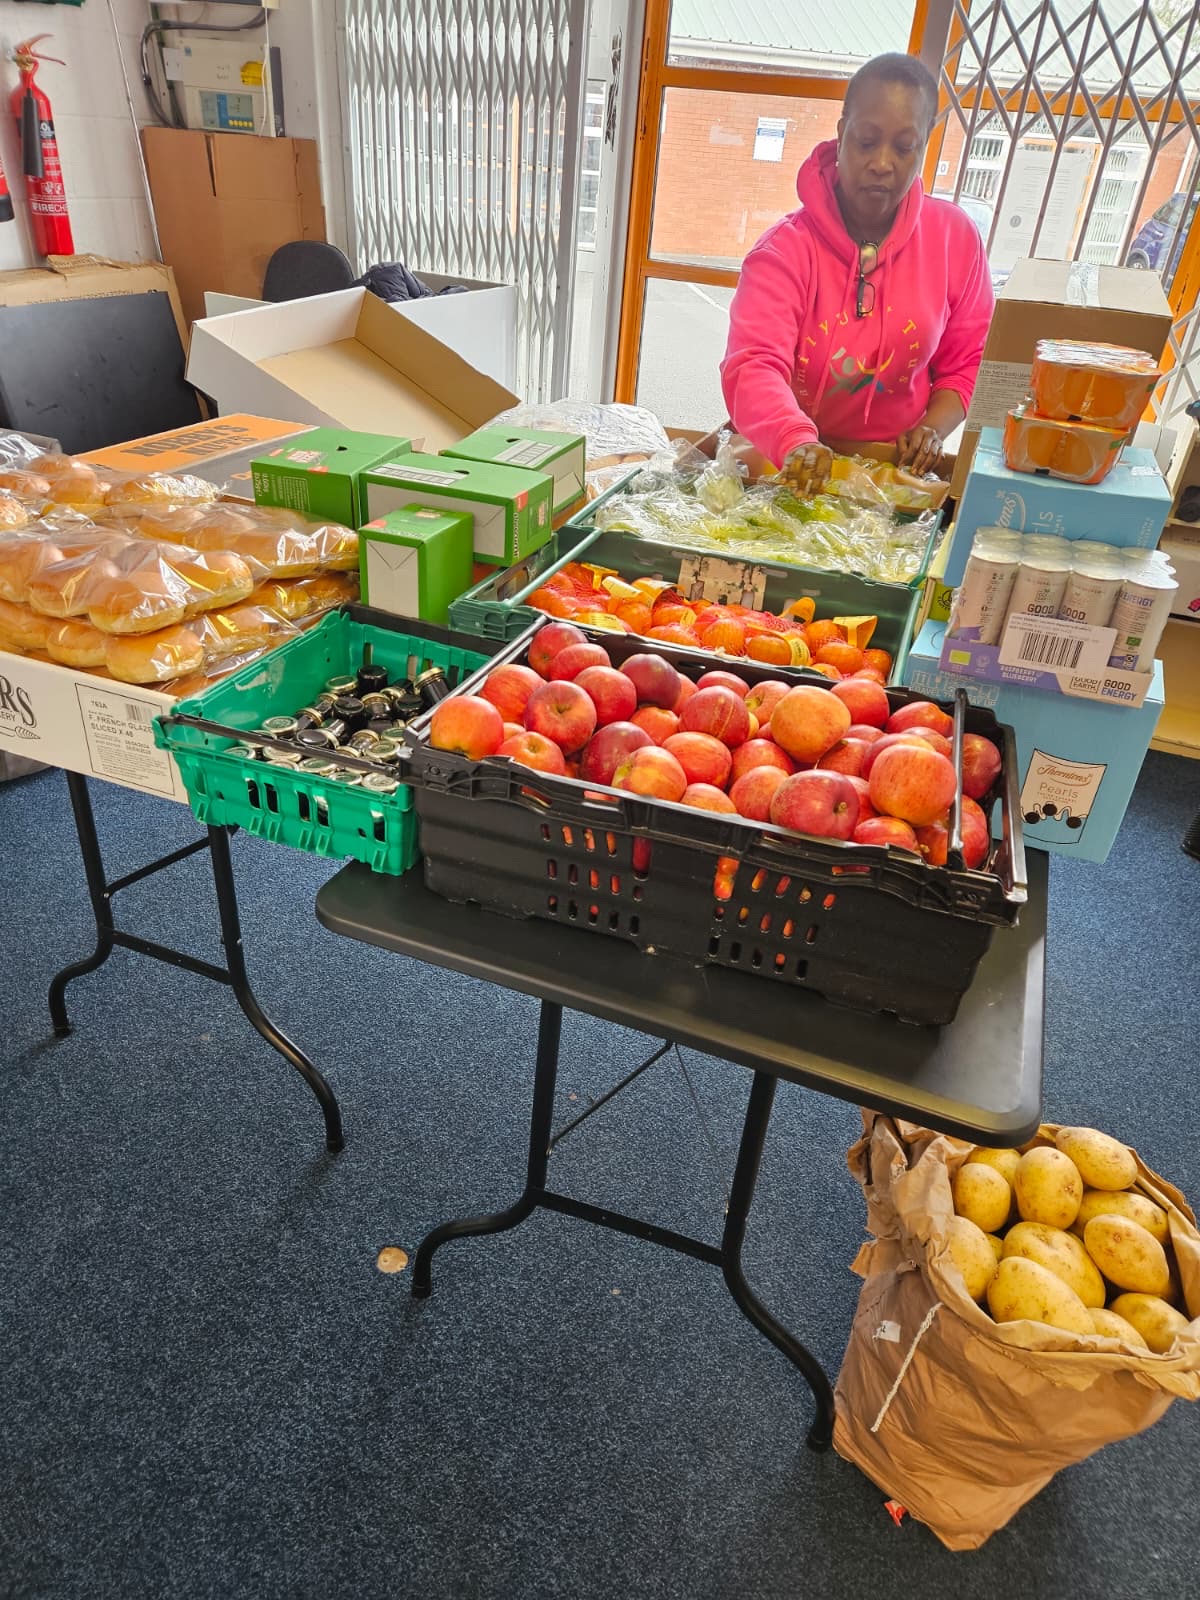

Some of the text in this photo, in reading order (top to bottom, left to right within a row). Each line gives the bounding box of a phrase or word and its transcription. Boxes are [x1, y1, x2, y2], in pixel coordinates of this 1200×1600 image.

[120, 425, 249, 457] NOBBY'S
[177, 436, 257, 456] NUTS
[1027, 603, 1054, 616] GOOD
[1104, 679, 1132, 692] GOOD
[0, 675, 37, 728] RS
[1101, 688, 1137, 702] ENERGY
[0, 710, 16, 723] ERY
[1037, 764, 1090, 784] Thorntons
[1039, 781, 1080, 799] Pearls
